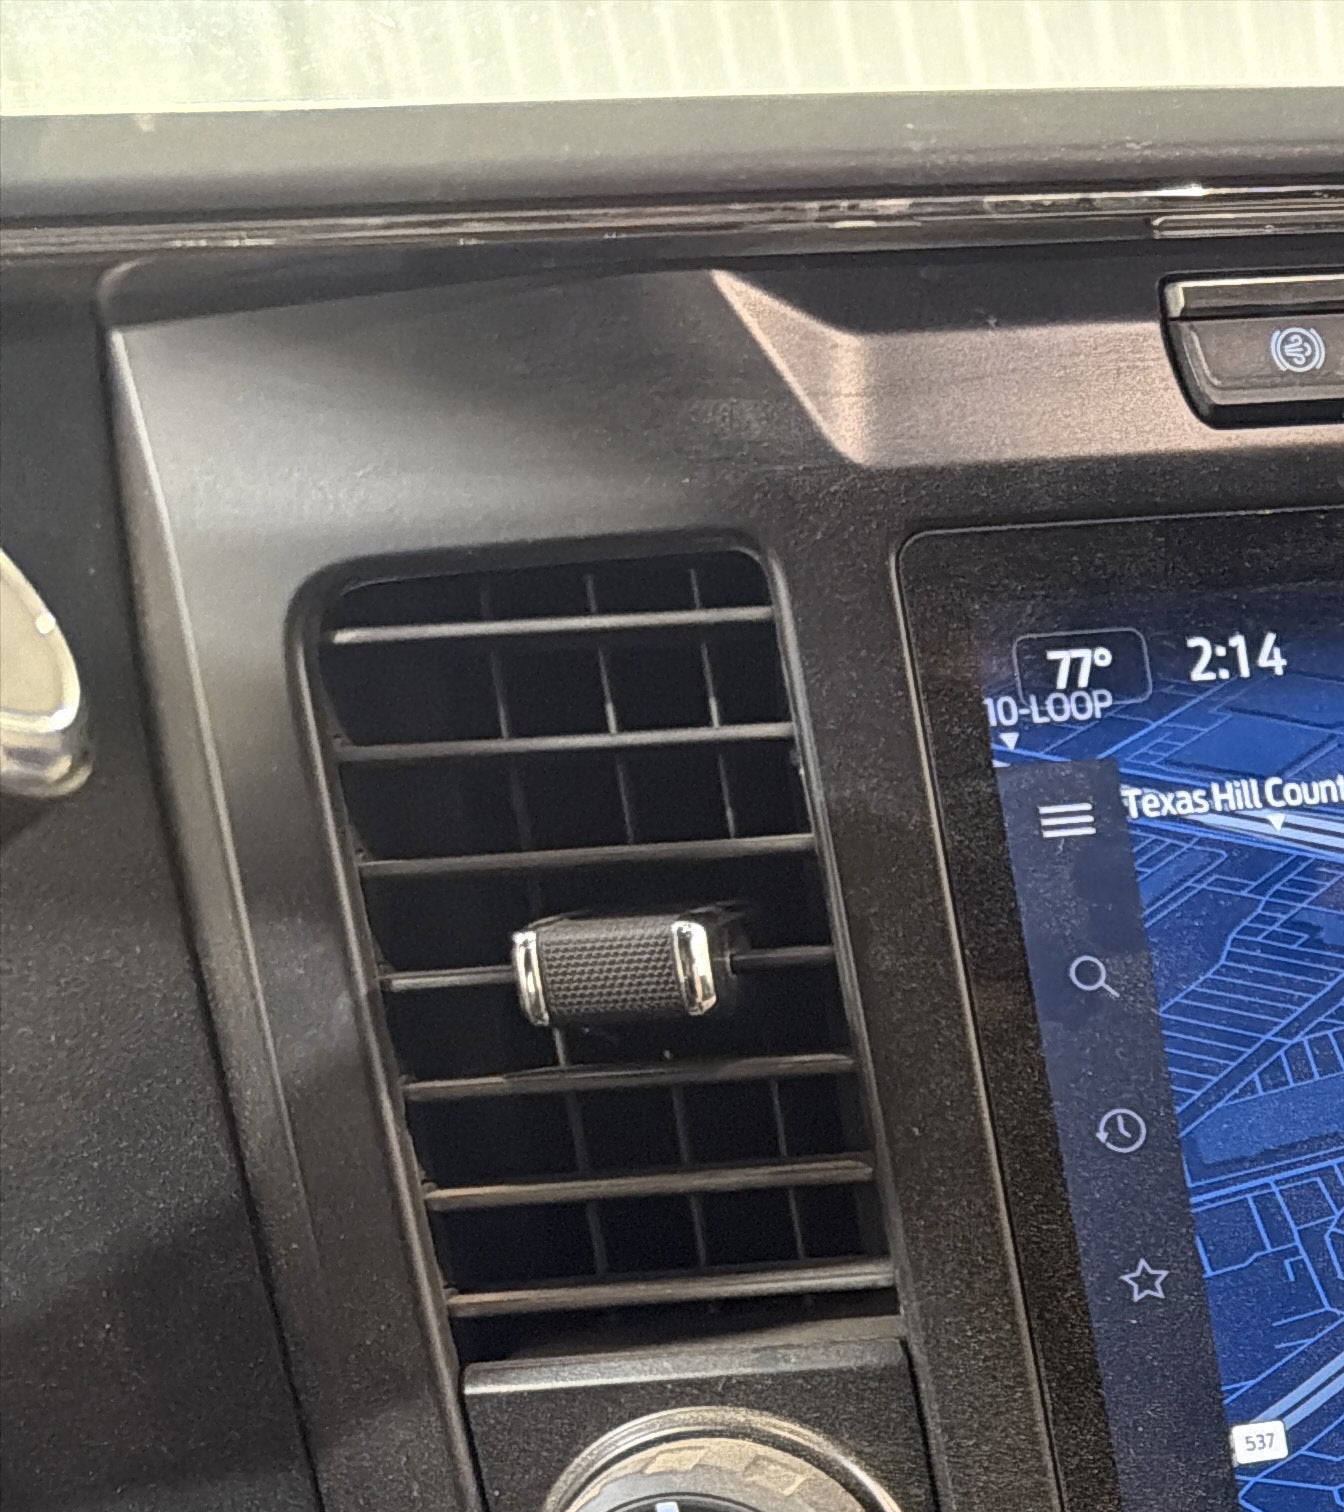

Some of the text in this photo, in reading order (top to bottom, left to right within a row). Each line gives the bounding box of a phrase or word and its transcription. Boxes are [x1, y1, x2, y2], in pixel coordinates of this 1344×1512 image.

[1046, 646, 1113, 690] 77°
[1186, 631, 1287, 682] 2:14
[982, 688, 1113, 727] 10-LOOP
[1121, 784, 1209, 821] Texas
[1212, 779, 1261, 812] Hill
[1244, 1432, 1275, 1453] 537
